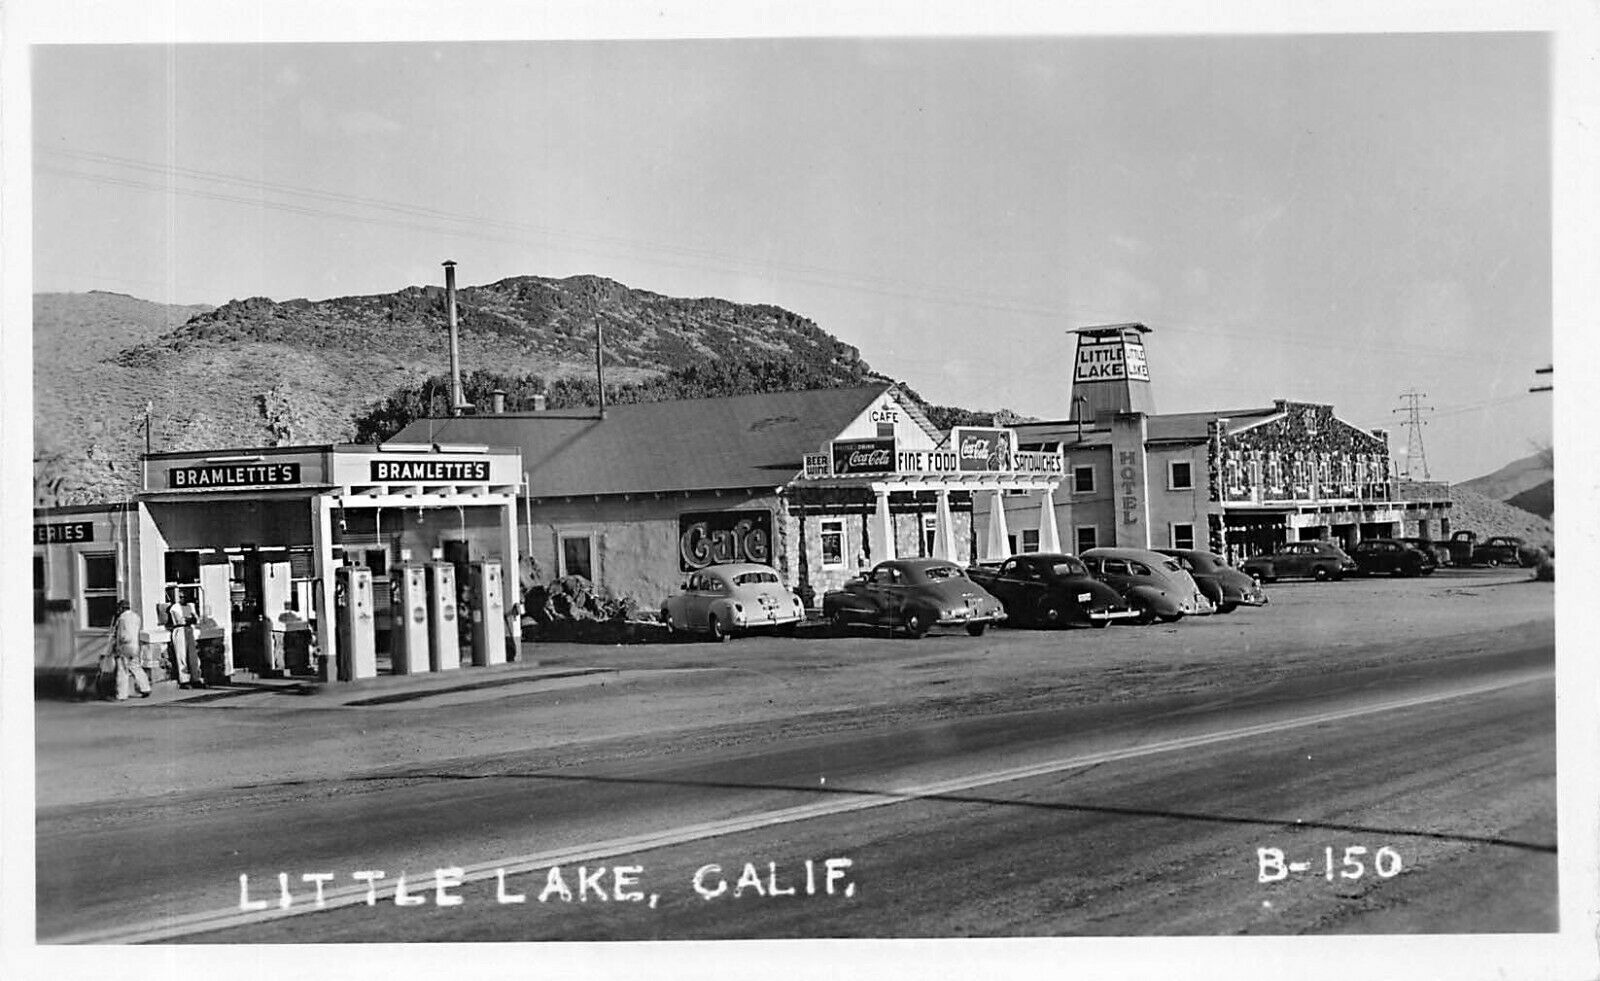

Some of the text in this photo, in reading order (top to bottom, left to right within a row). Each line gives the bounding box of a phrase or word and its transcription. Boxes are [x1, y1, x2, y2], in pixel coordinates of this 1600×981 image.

[1080, 348, 1123, 363] LITTLE
[1077, 363, 1124, 378] LAKE
[871, 411, 899, 423] CAFE
[806, 456, 828, 466] BEER
[898, 452, 957, 471] FINE FOOD
[1013, 454, 1061, 471] SANDWICHES
[176, 464, 293, 485] BRAMLETTE'S
[378, 461, 485, 479] BRAMLETTE'S
[807, 466, 828, 475] WINE
[1120, 451, 1137, 525] HOTEL
[34, 524, 84, 541] ERIES
